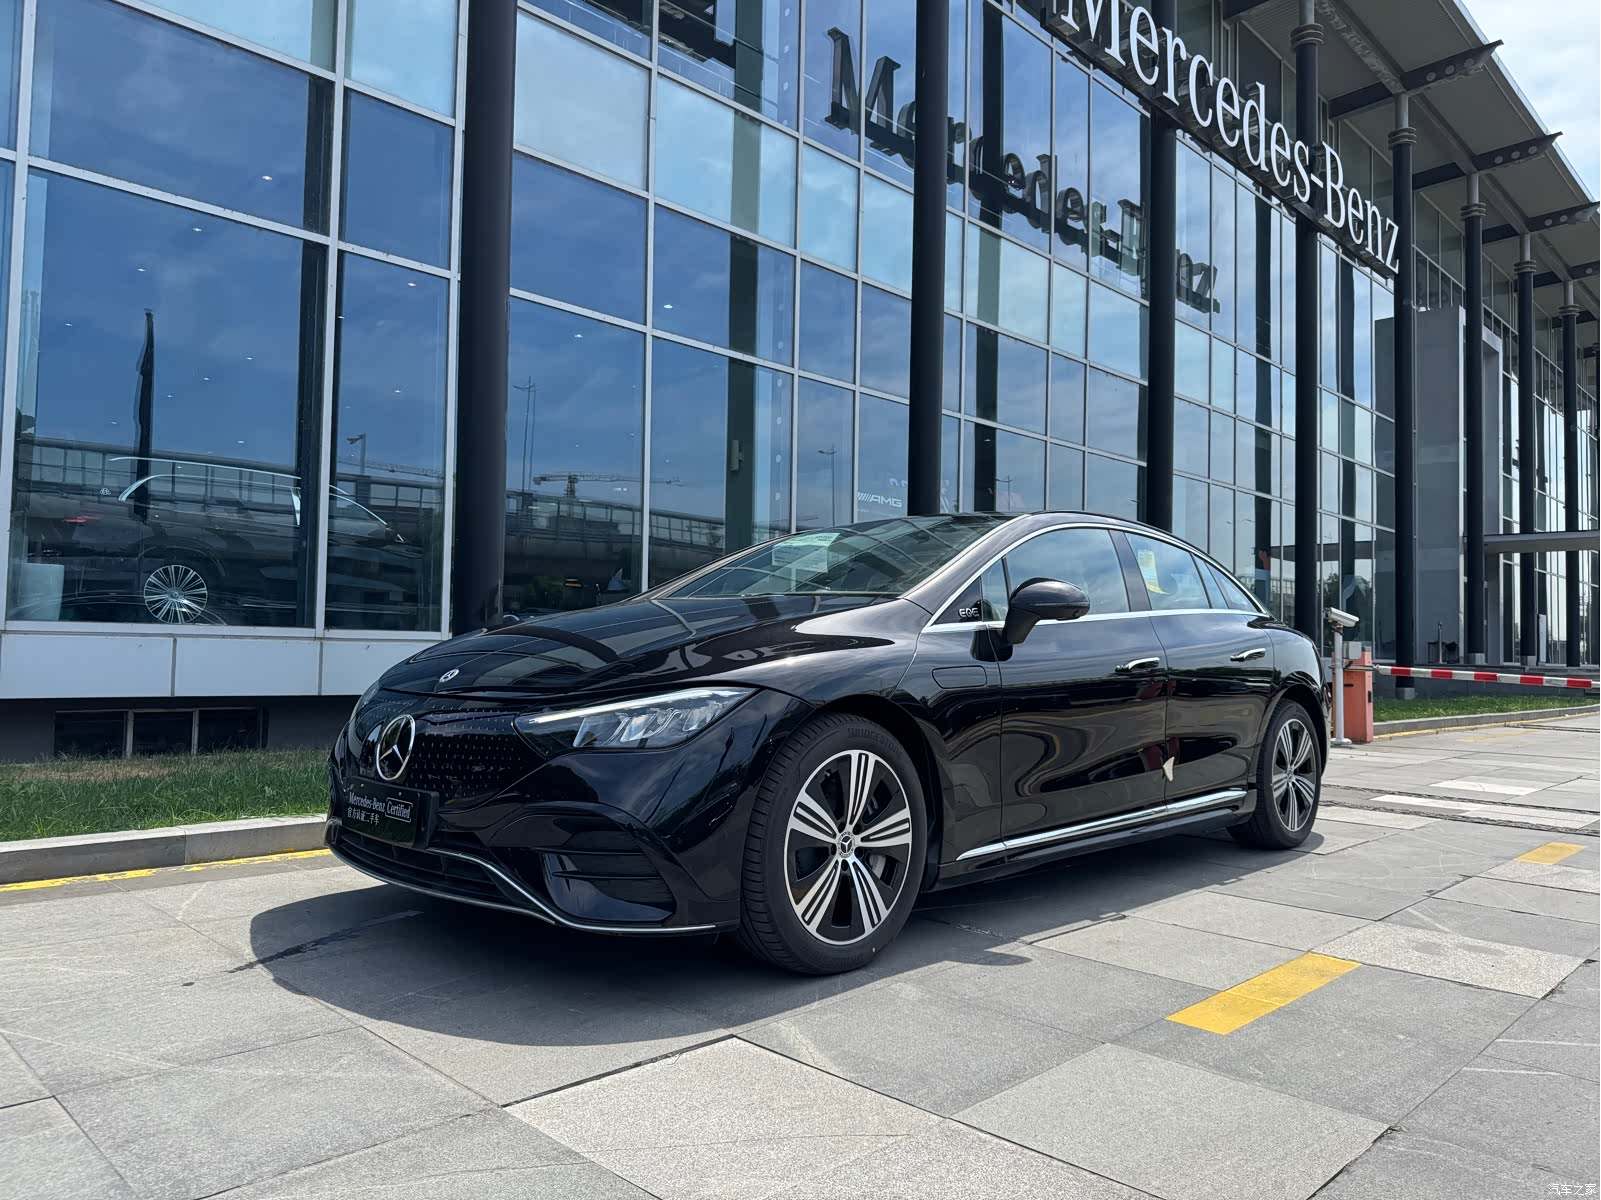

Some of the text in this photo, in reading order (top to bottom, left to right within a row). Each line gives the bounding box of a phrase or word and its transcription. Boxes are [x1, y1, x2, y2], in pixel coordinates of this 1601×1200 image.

[869, 494, 902, 508] AMG
[959, 607, 980, 617] EQE
[348, 791, 411, 819] Mercedes-Benz Certified
[347, 806, 380, 826] 官方认证二手车
